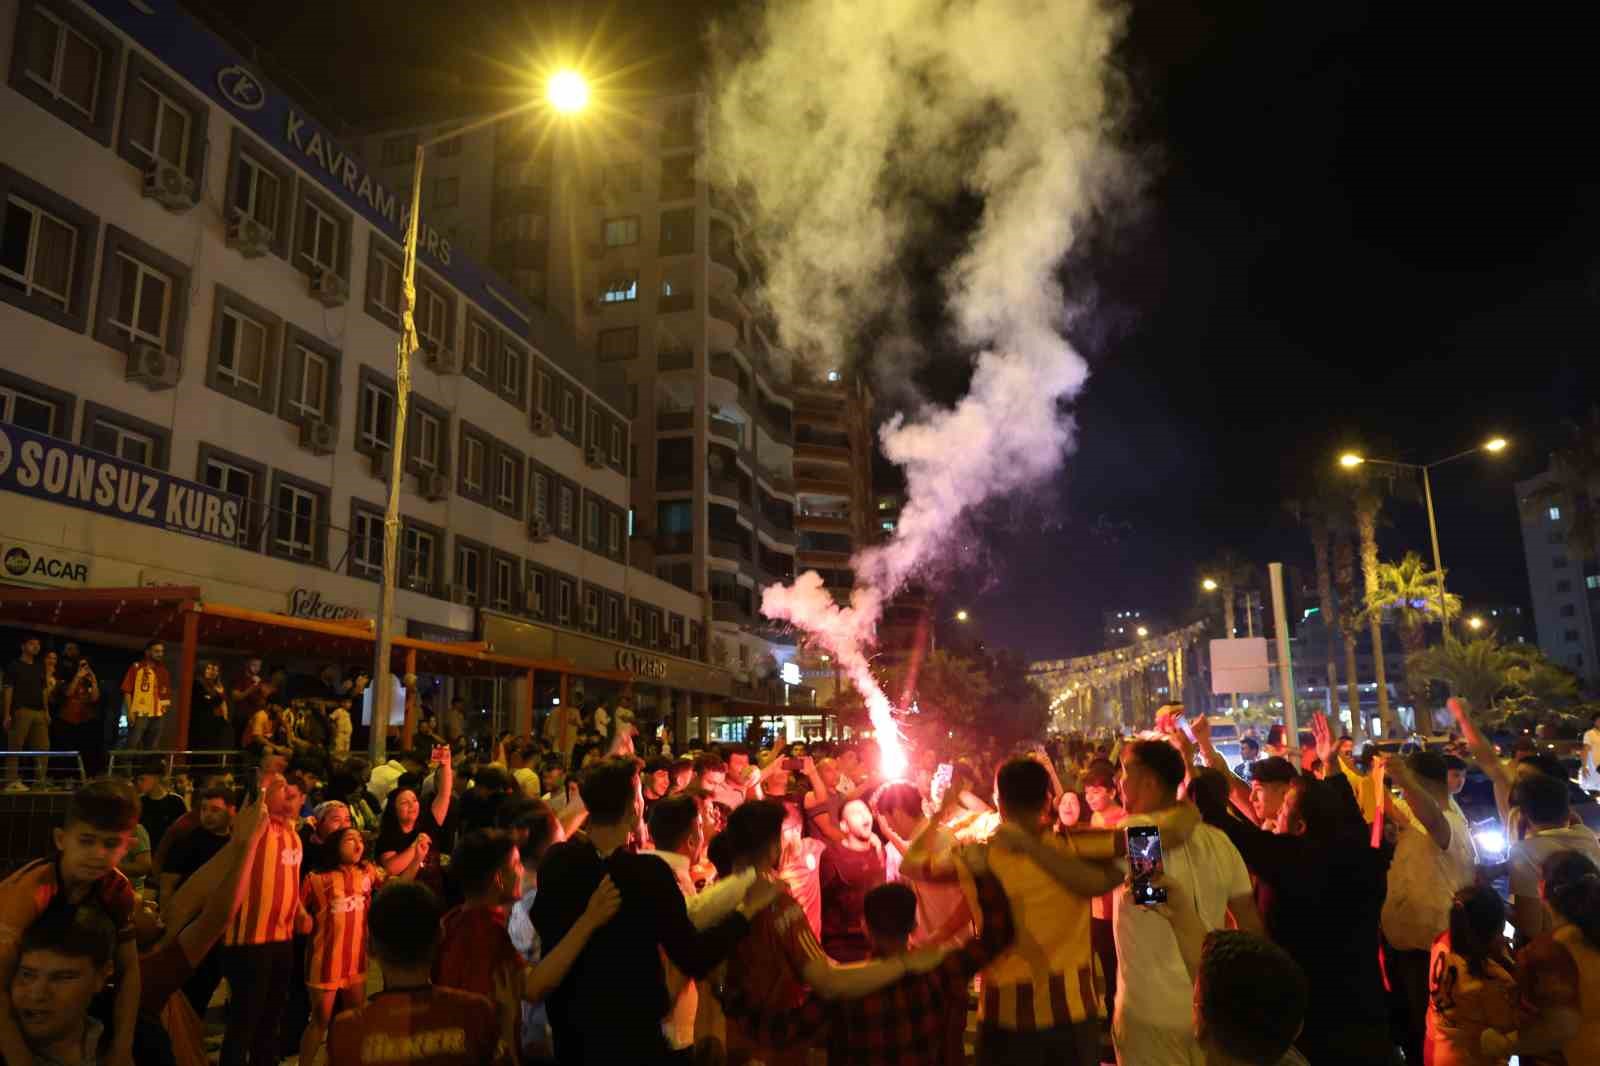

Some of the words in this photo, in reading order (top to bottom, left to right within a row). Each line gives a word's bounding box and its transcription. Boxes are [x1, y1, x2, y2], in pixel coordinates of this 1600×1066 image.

[287, 109, 396, 222] KAVRAM
[16, 440, 160, 519] SONSUZ
[165, 482, 239, 539] KURS
[33, 556, 88, 582] ACAR
